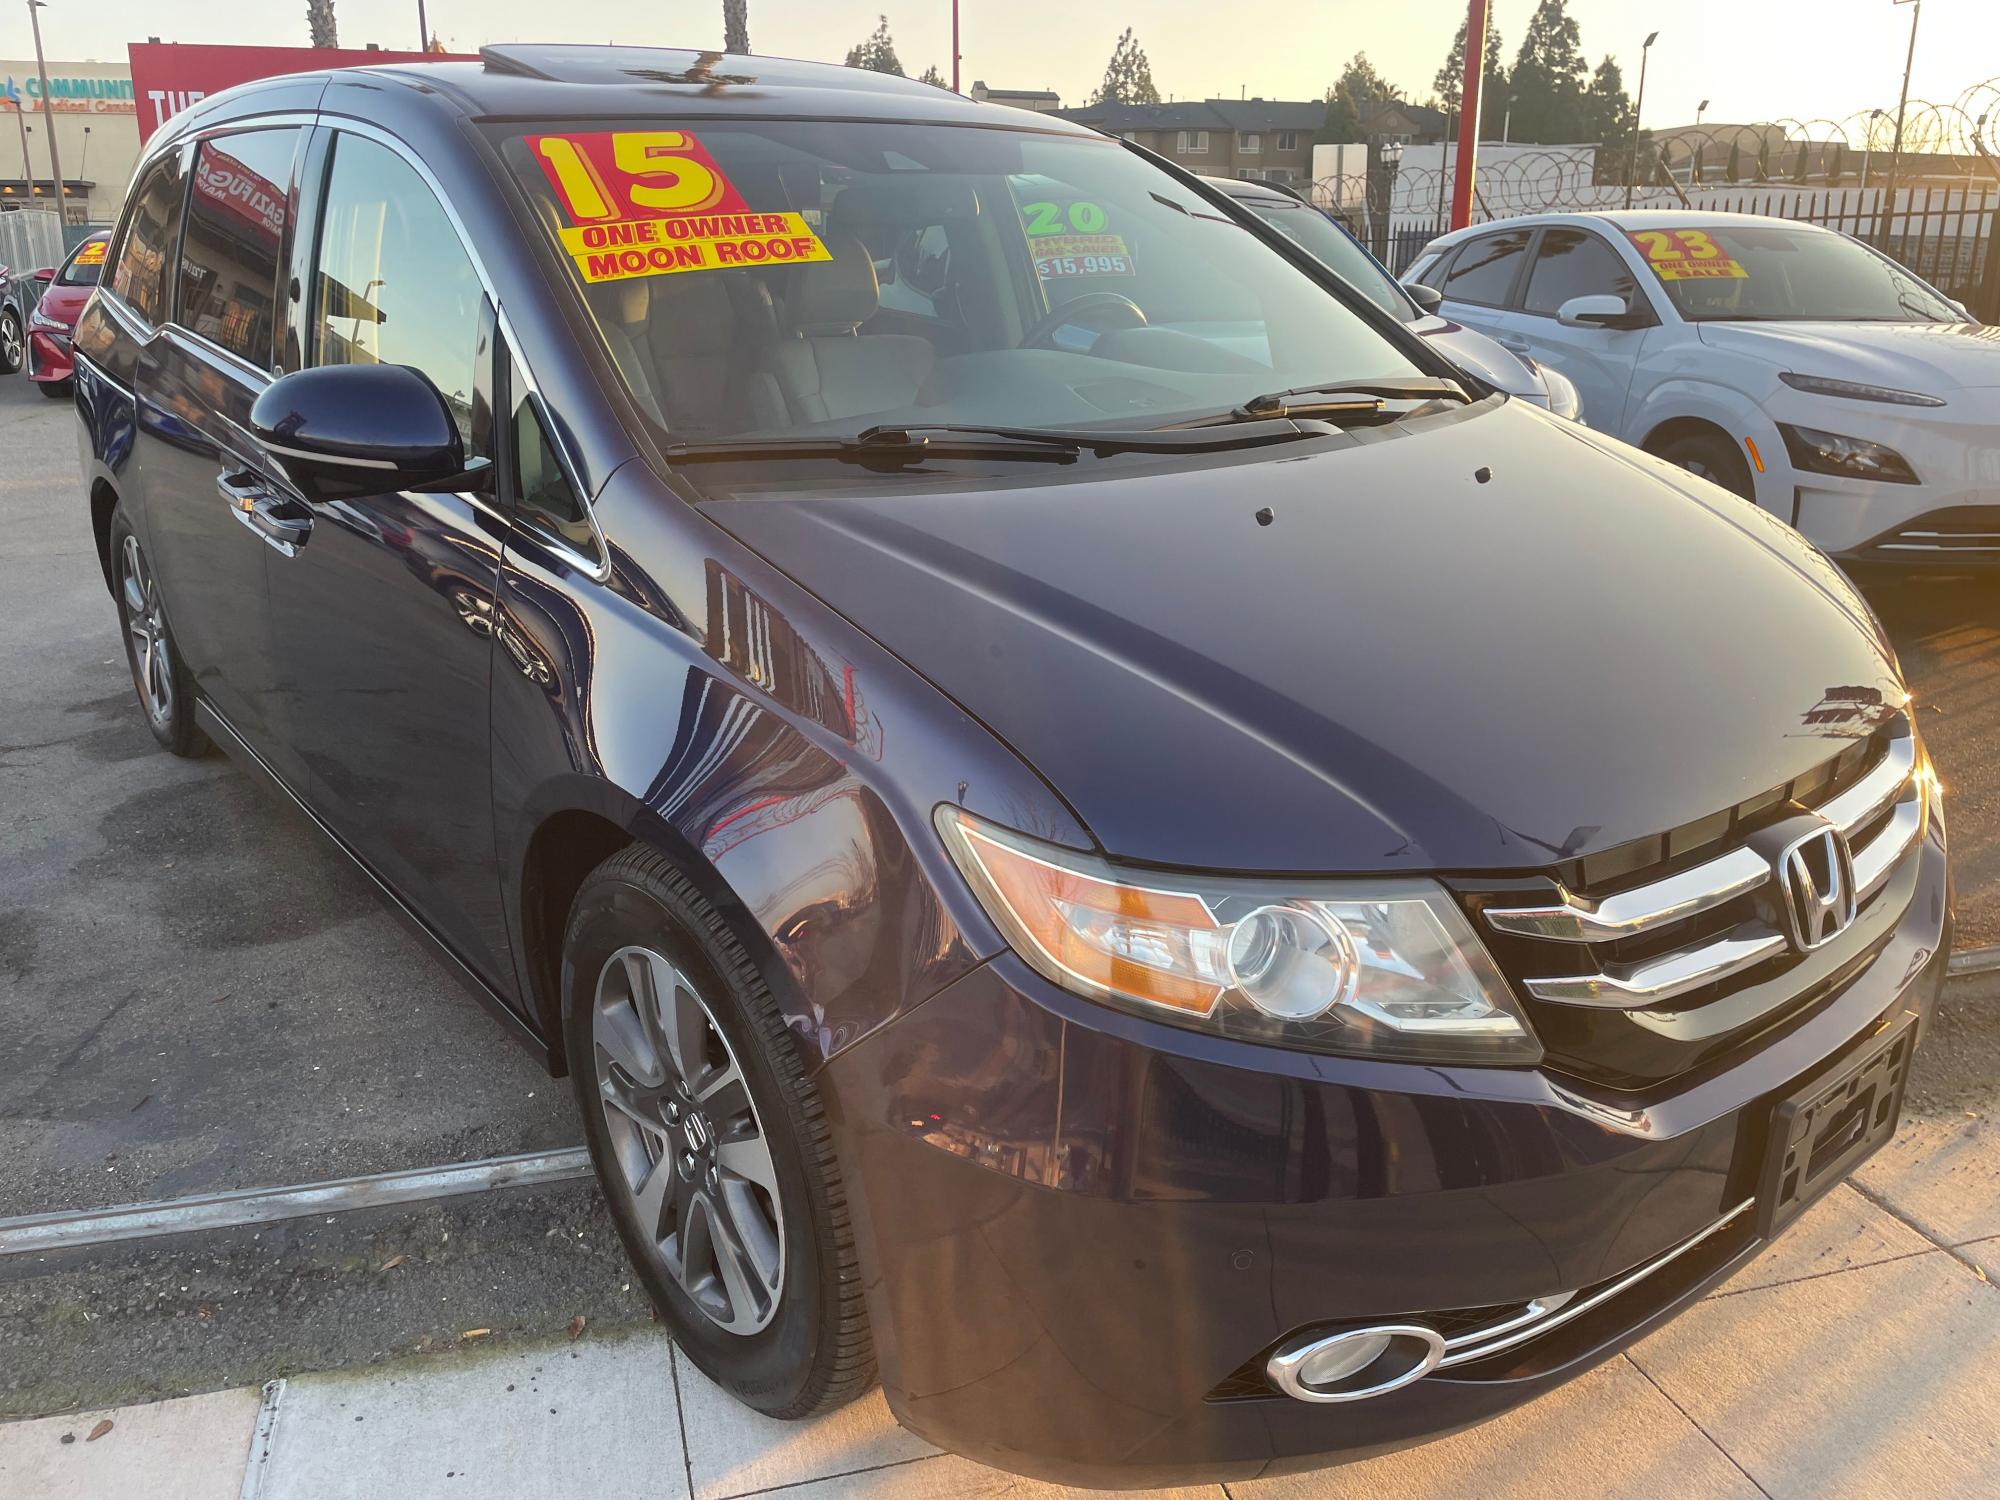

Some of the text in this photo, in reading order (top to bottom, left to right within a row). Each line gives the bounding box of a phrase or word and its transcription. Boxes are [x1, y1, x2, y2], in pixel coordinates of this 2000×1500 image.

[540, 131, 723, 220] 15
[582, 213, 791, 249] ONE OWNER
[1023, 202, 1107, 235] 20
[587, 237, 817, 278] MOON ROOF
[1635, 230, 1720, 260] 23
[1040, 257, 1126, 275] $15,995
